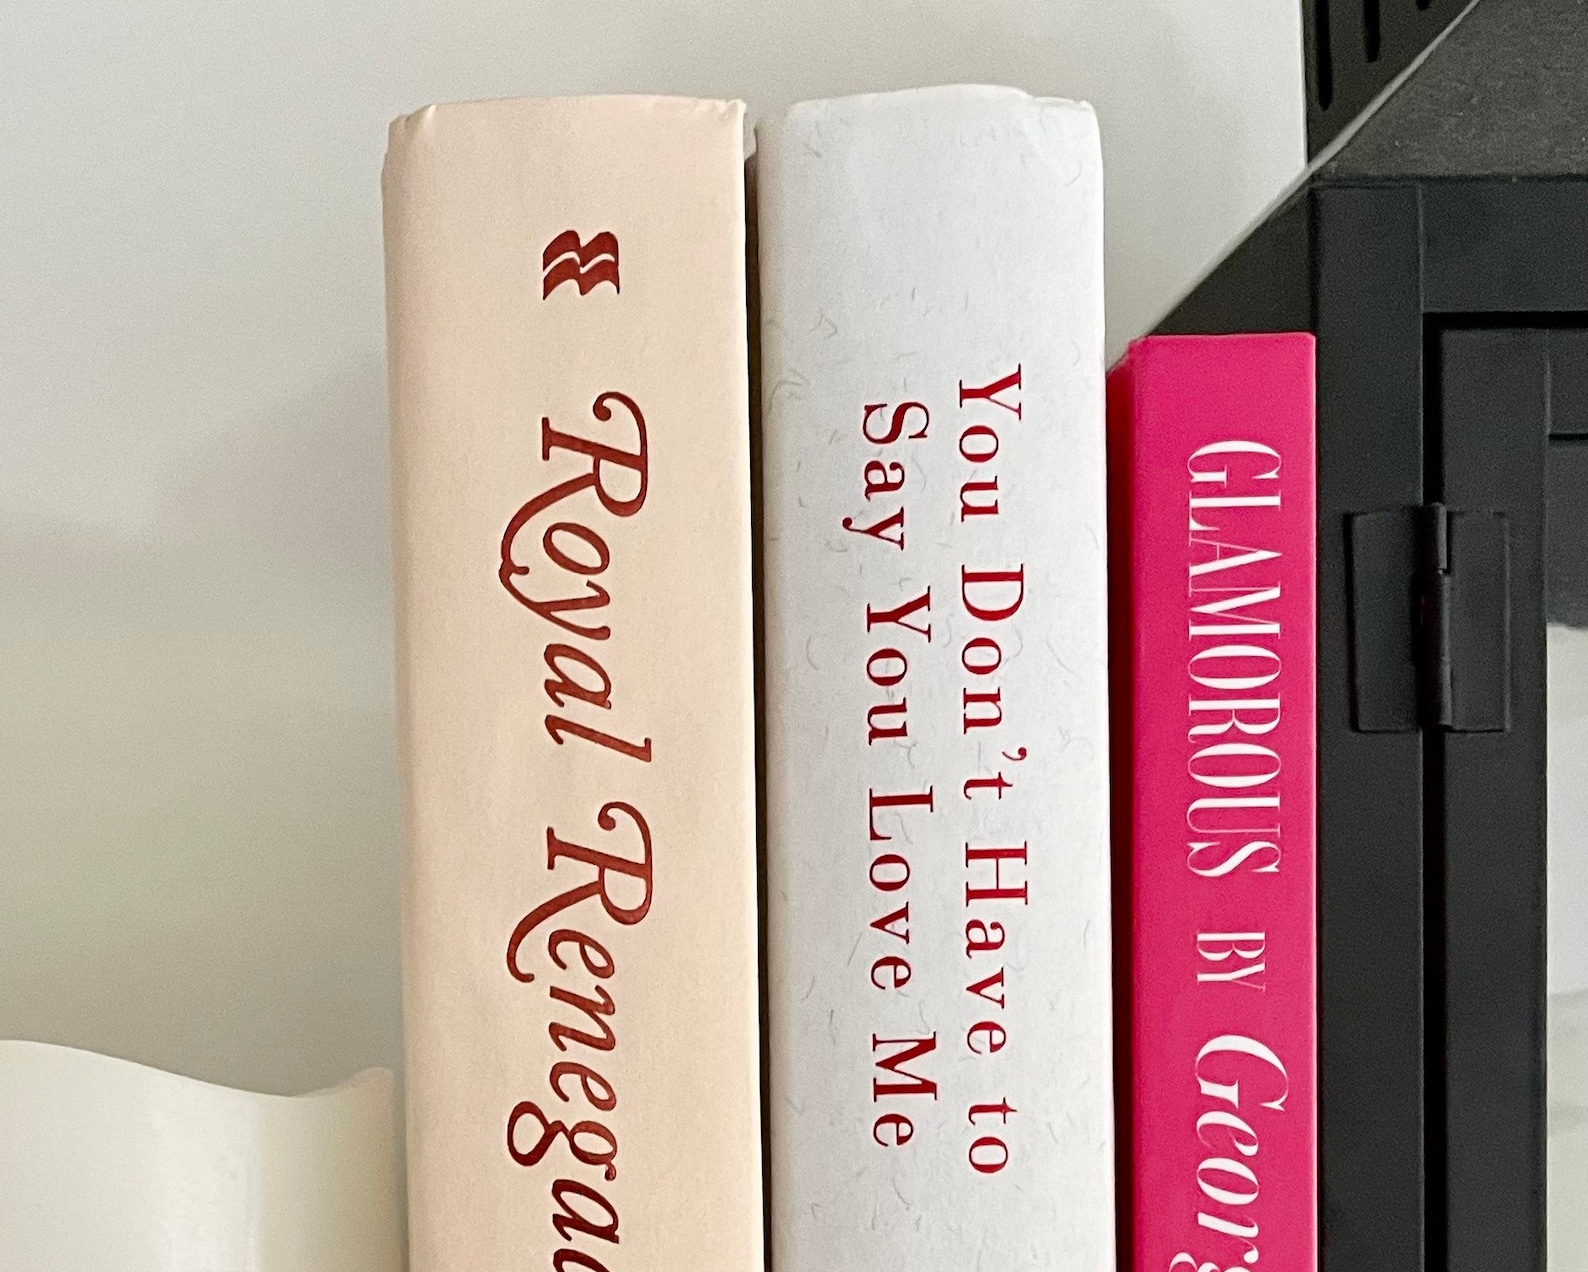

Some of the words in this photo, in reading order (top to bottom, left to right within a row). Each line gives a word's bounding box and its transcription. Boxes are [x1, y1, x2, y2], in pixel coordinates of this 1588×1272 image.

[842, 400, 928, 550] Say
[958, 365, 1023, 522] You
[498, 391, 653, 763] Royal
[865, 586, 933, 745] You
[961, 564, 1028, 800] Don't
[1186, 439, 1283, 879] GLAMOROUS
[868, 787, 935, 990] Love
[964, 841, 1029, 1055] Have
[1196, 931, 1266, 992] BY
[871, 1031, 938, 1148] Me
[967, 1097, 1016, 1176] to
